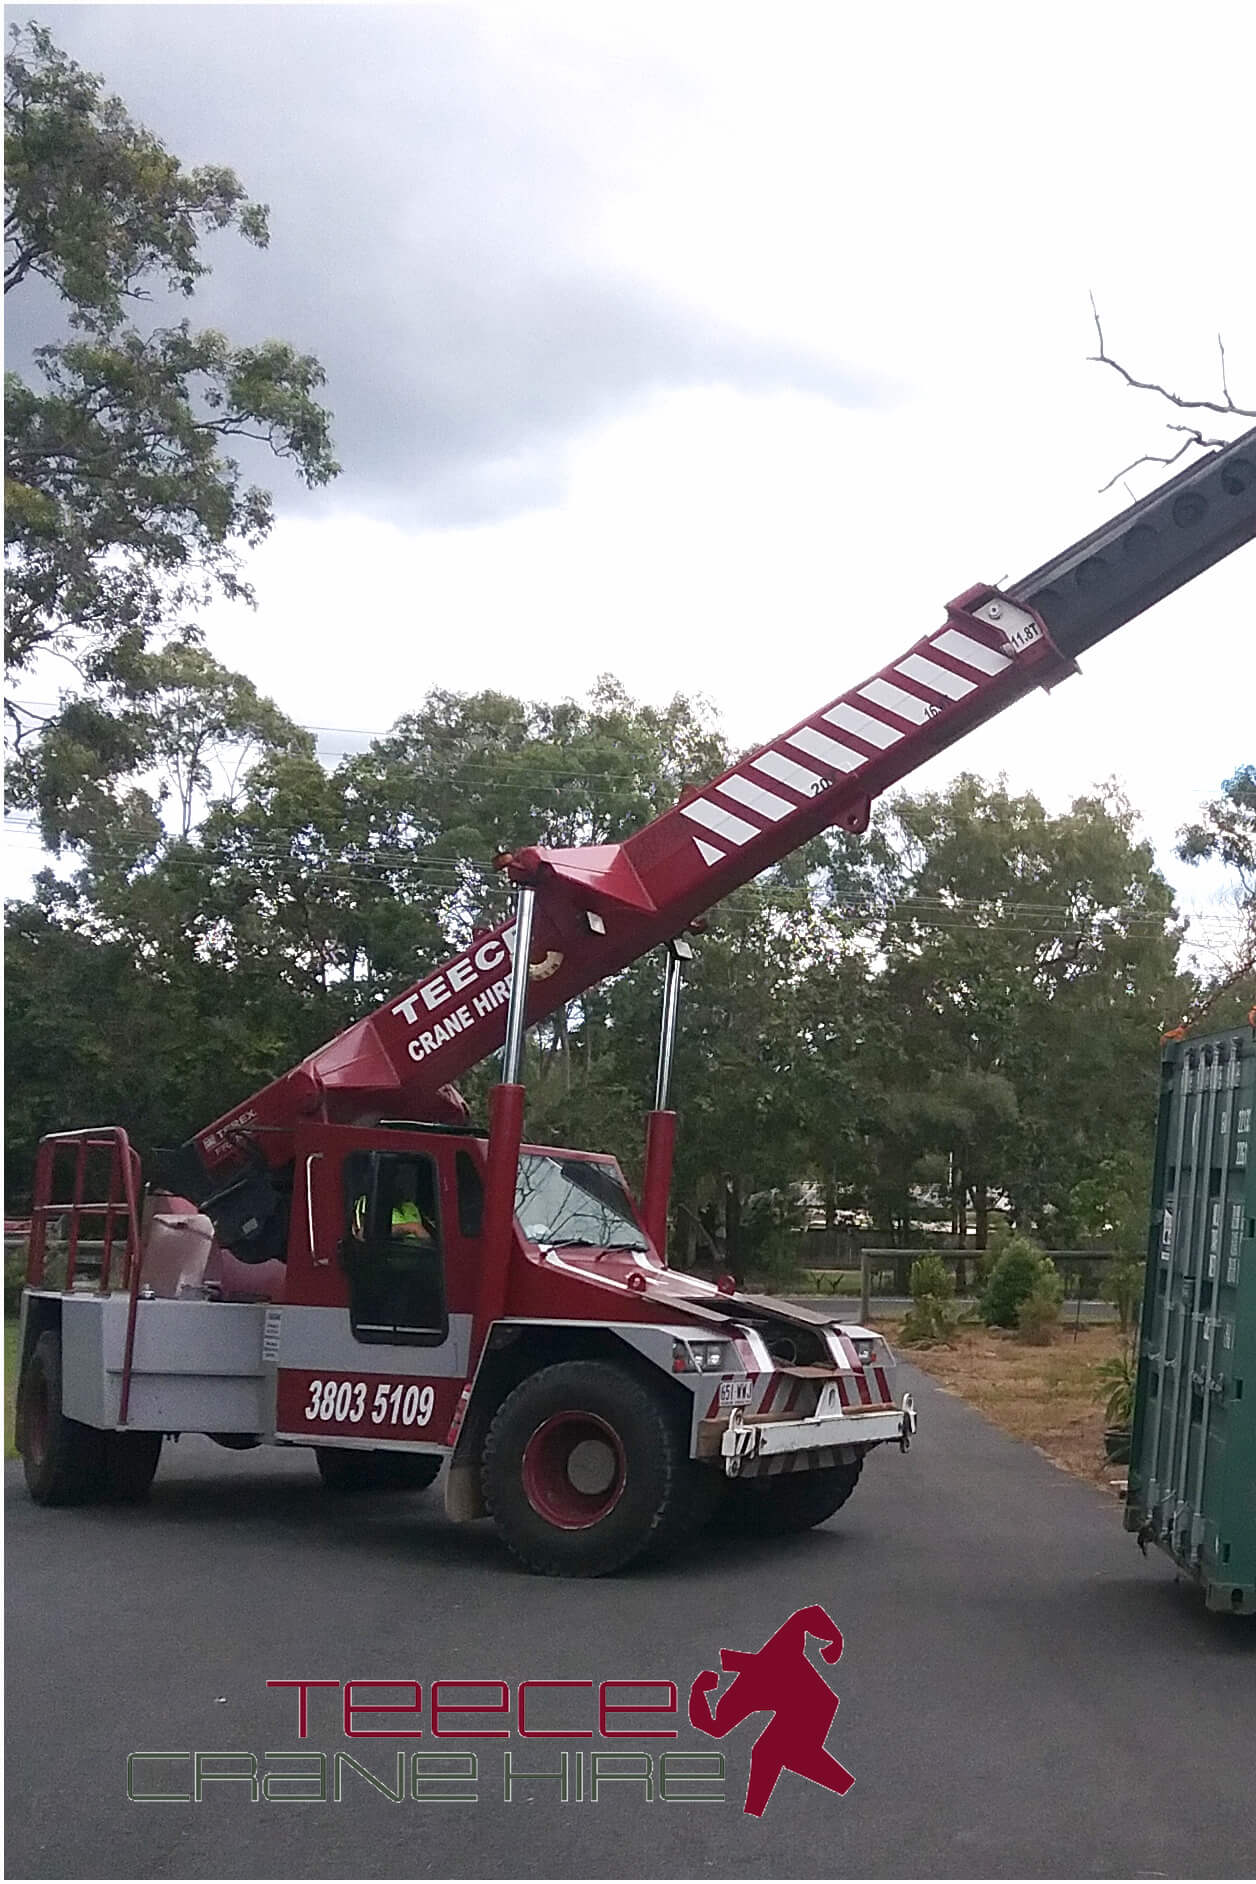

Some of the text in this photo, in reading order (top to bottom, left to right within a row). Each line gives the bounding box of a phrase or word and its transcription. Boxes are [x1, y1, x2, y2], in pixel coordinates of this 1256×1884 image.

[1010, 622, 1039, 649] 11.8T
[407, 1004, 475, 1063] CRANE
[305, 1380, 435, 1427] 3803 5109
